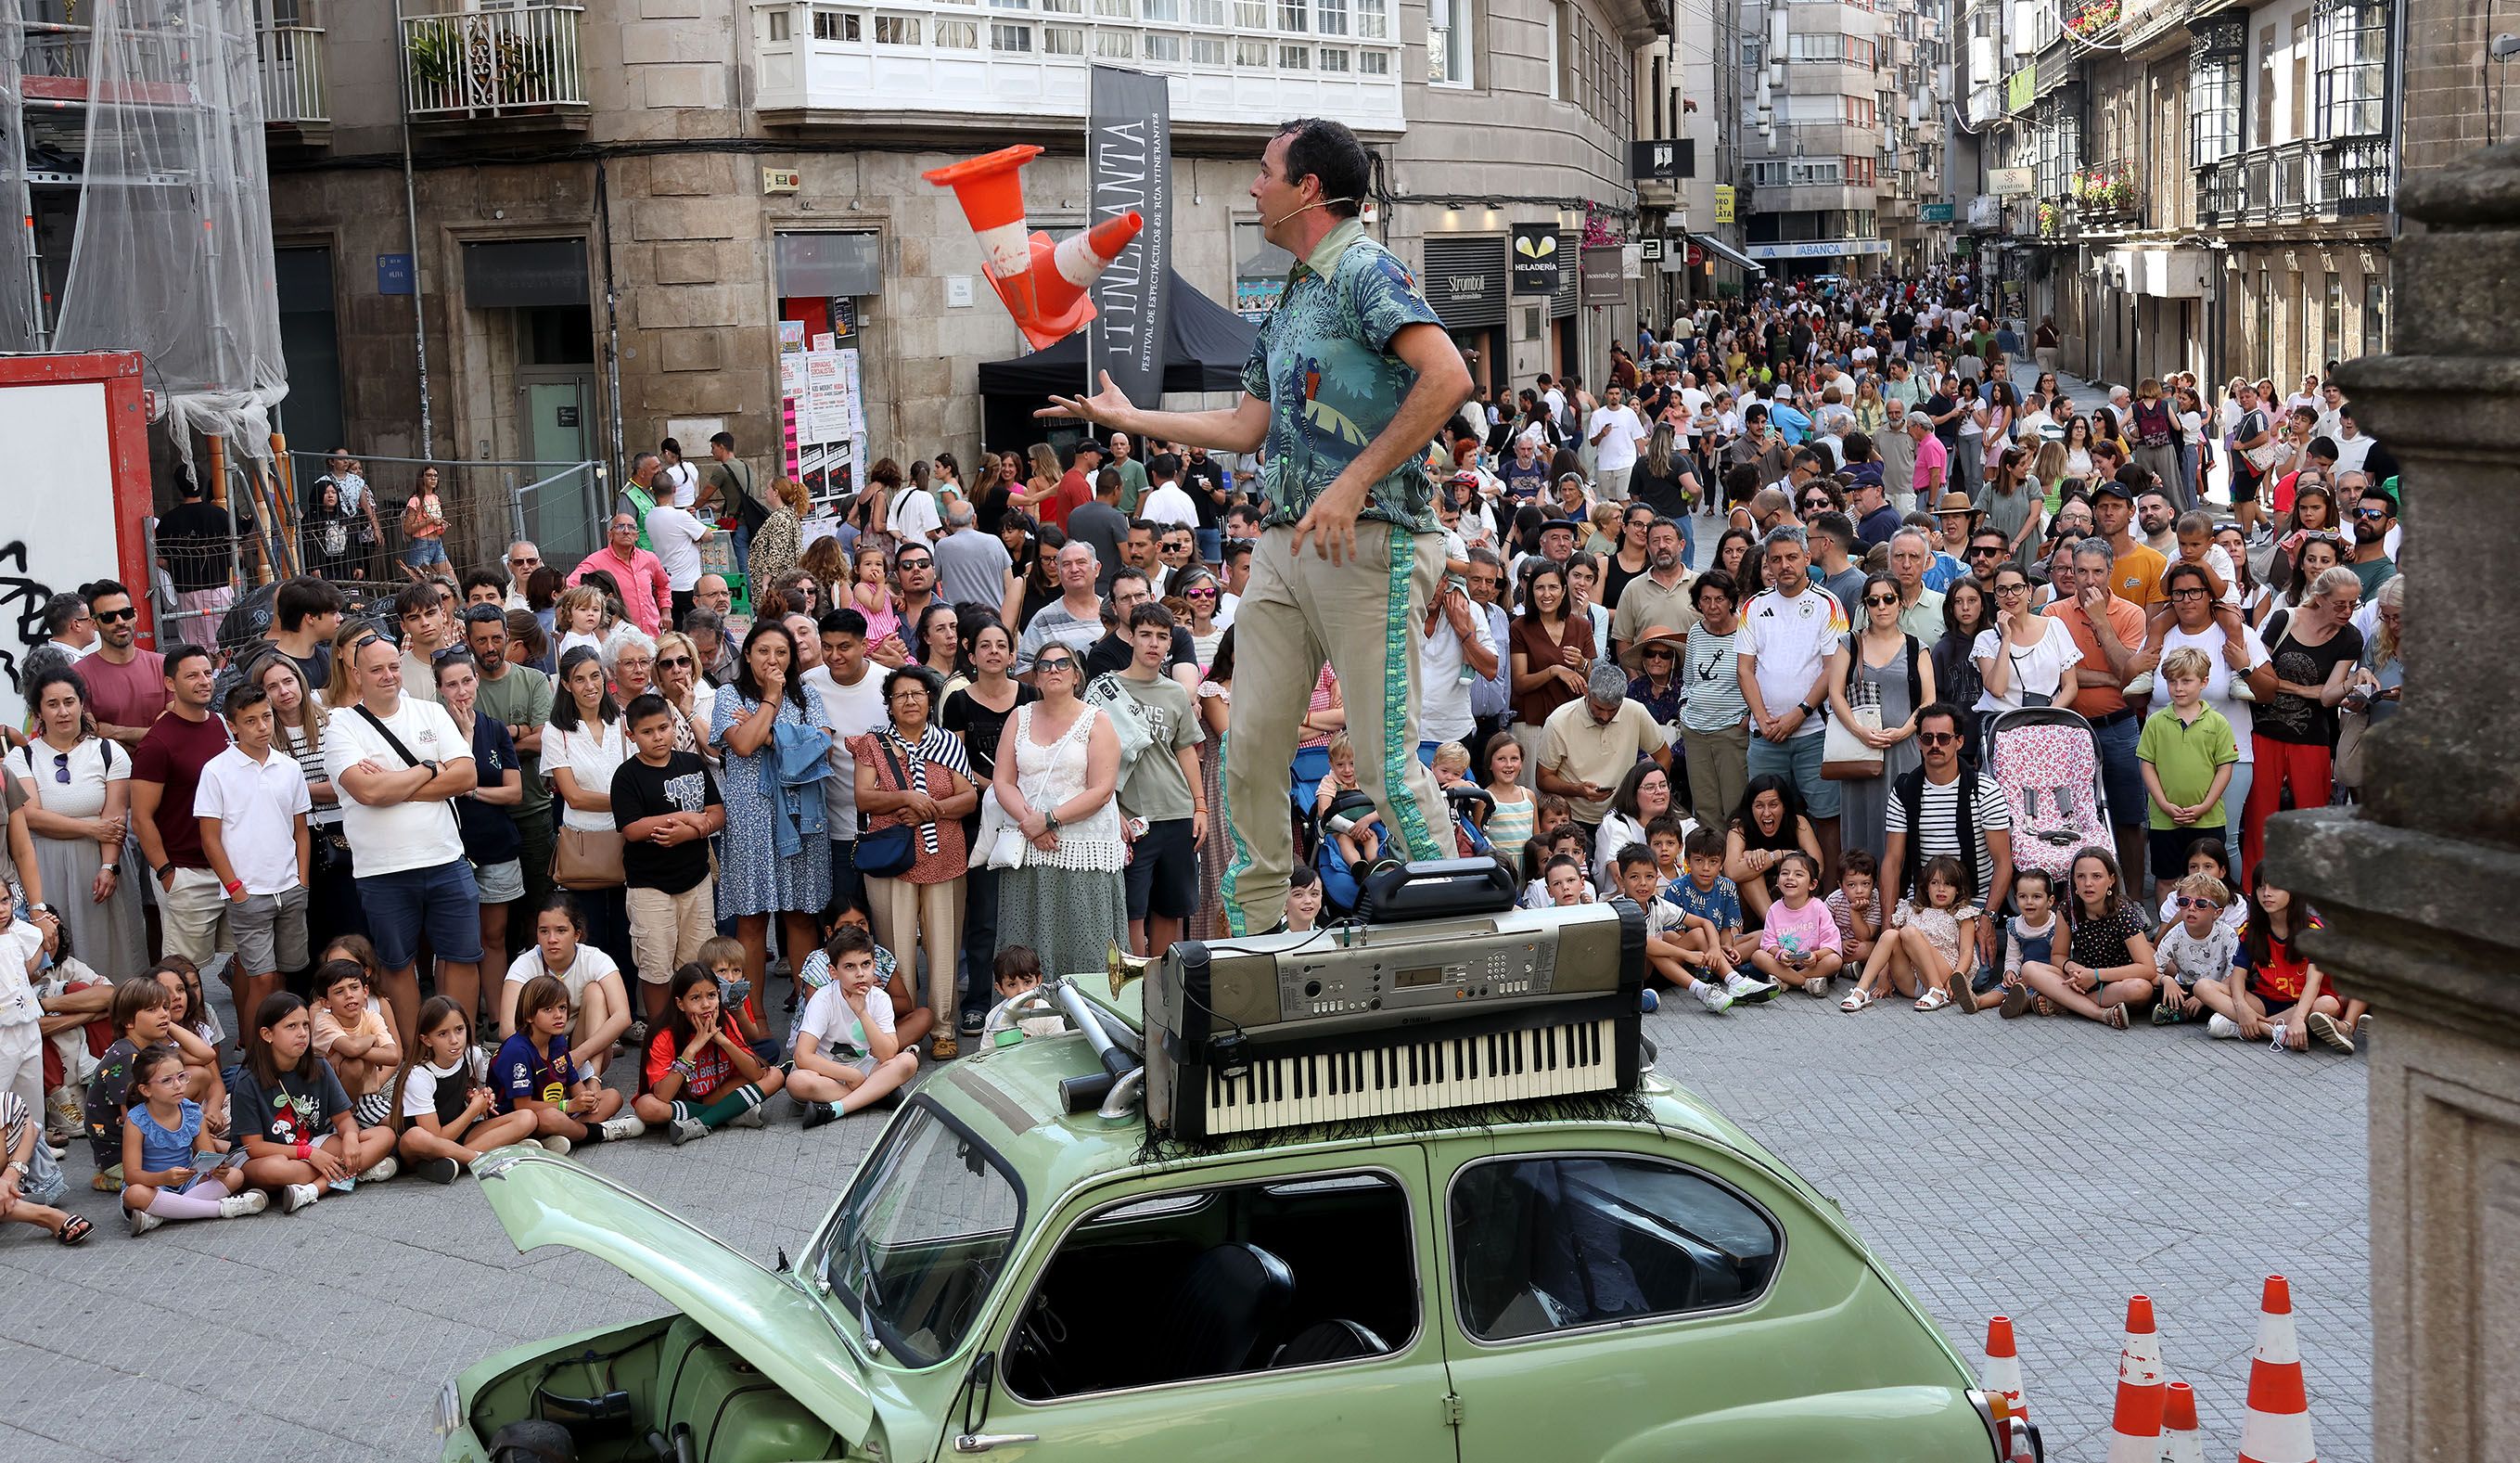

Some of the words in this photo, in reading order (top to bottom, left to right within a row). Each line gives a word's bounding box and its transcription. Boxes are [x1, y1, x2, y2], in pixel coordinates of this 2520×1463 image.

[1152, 112, 1162, 185] ITINERANTES
[1095, 119, 1145, 355] ITINEANTA
[1149, 228, 1162, 308] ESPECTÁCULOS
[1515, 262, 1558, 271] HELADERÍA
[1448, 275, 1484, 291] Stromboli
[1142, 327, 1154, 372] FESTIVAL
[1775, 920, 1814, 936] SUMMER
[699, 1060, 730, 1079] BREEZ
